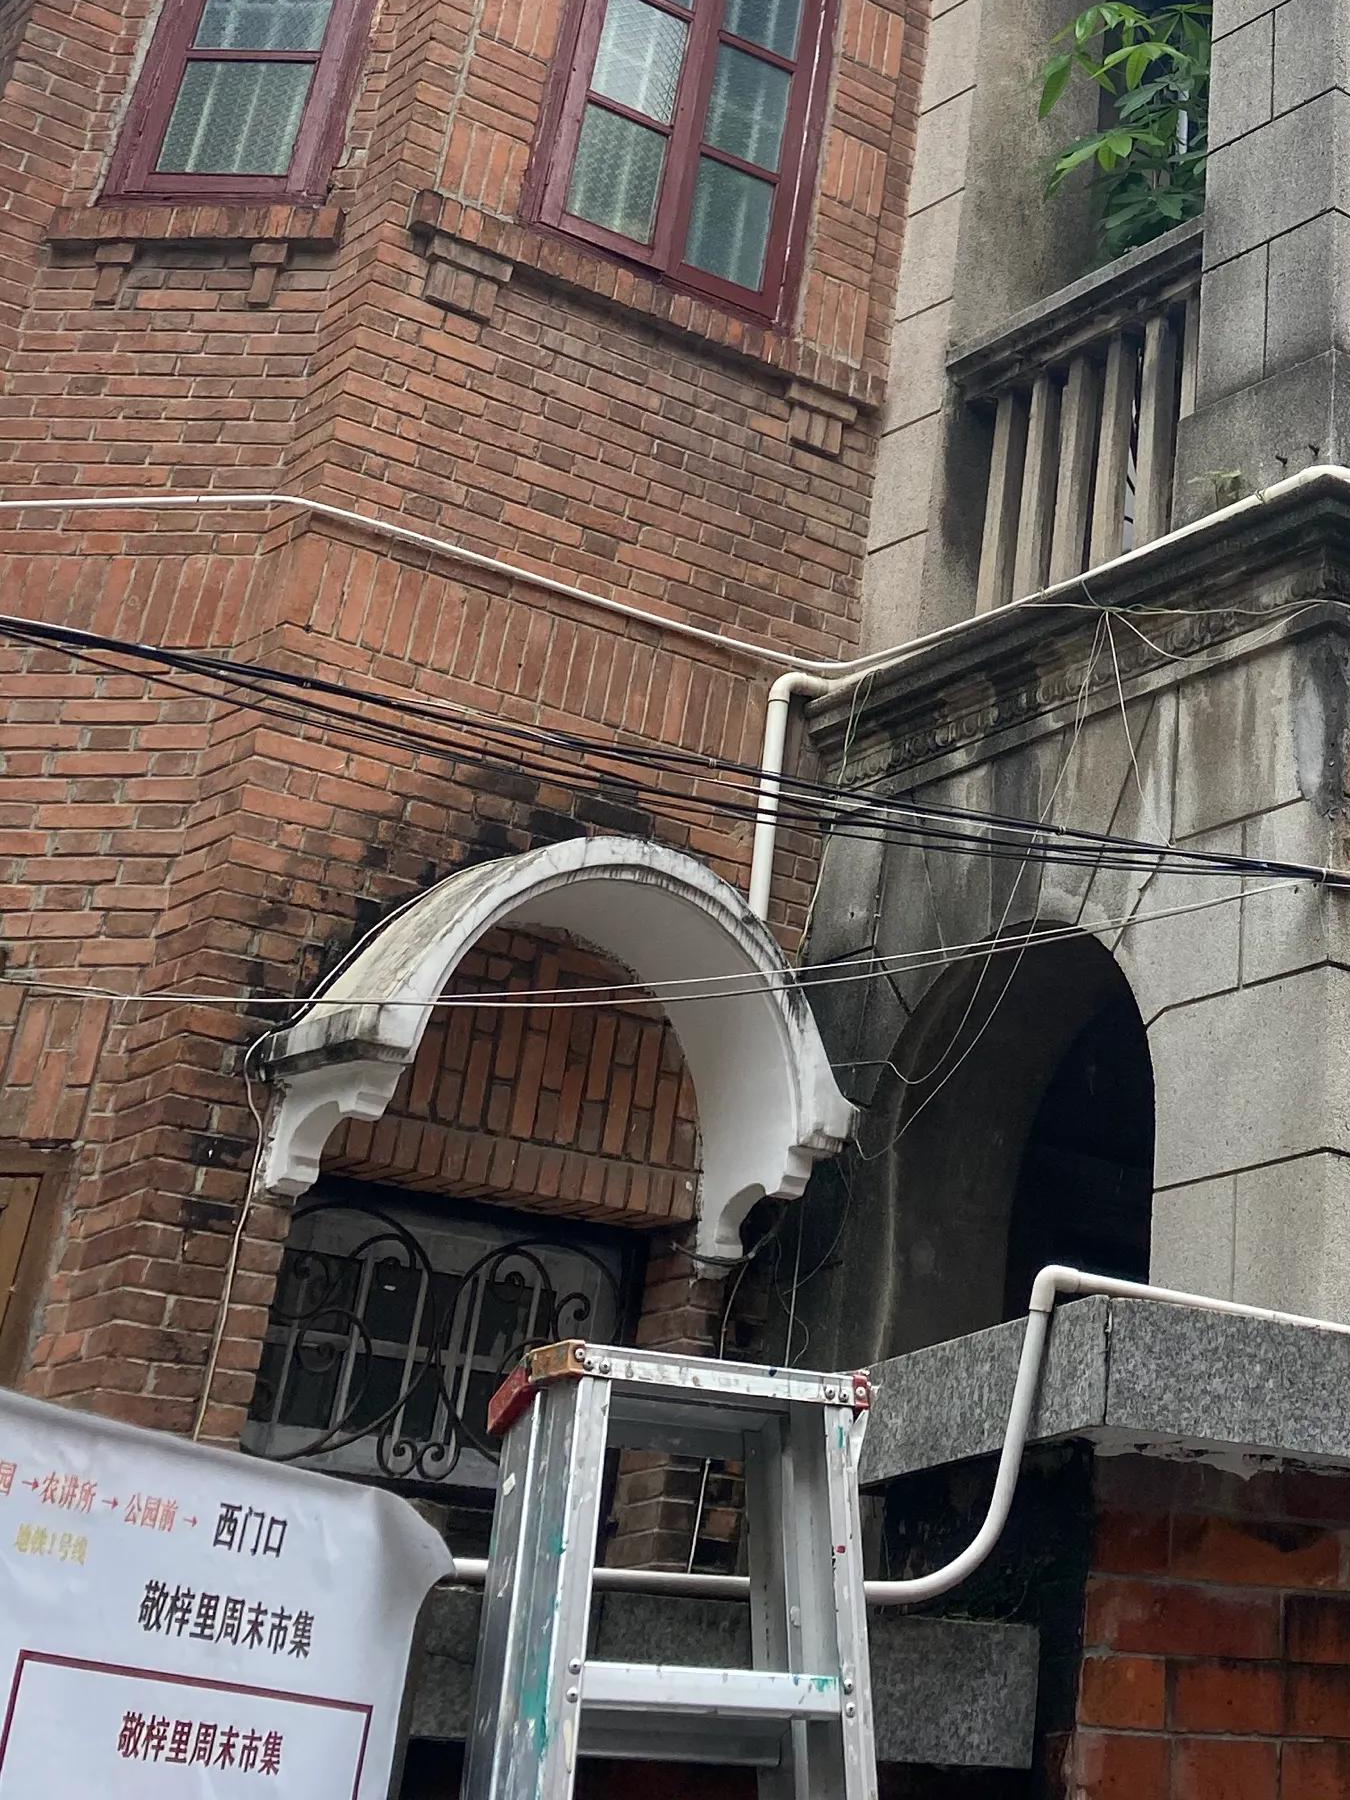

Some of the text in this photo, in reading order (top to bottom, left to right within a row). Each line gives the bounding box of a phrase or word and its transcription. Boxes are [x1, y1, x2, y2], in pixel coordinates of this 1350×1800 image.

[39, 1470, 98, 1513] 农讲所
[124, 1492, 178, 1532] 公园前
[212, 1502, 288, 1558] 西门口
[138, 1579, 315, 1659] 敬梓里周末市集
[117, 1711, 283, 1776] 敬梓里周末市集
